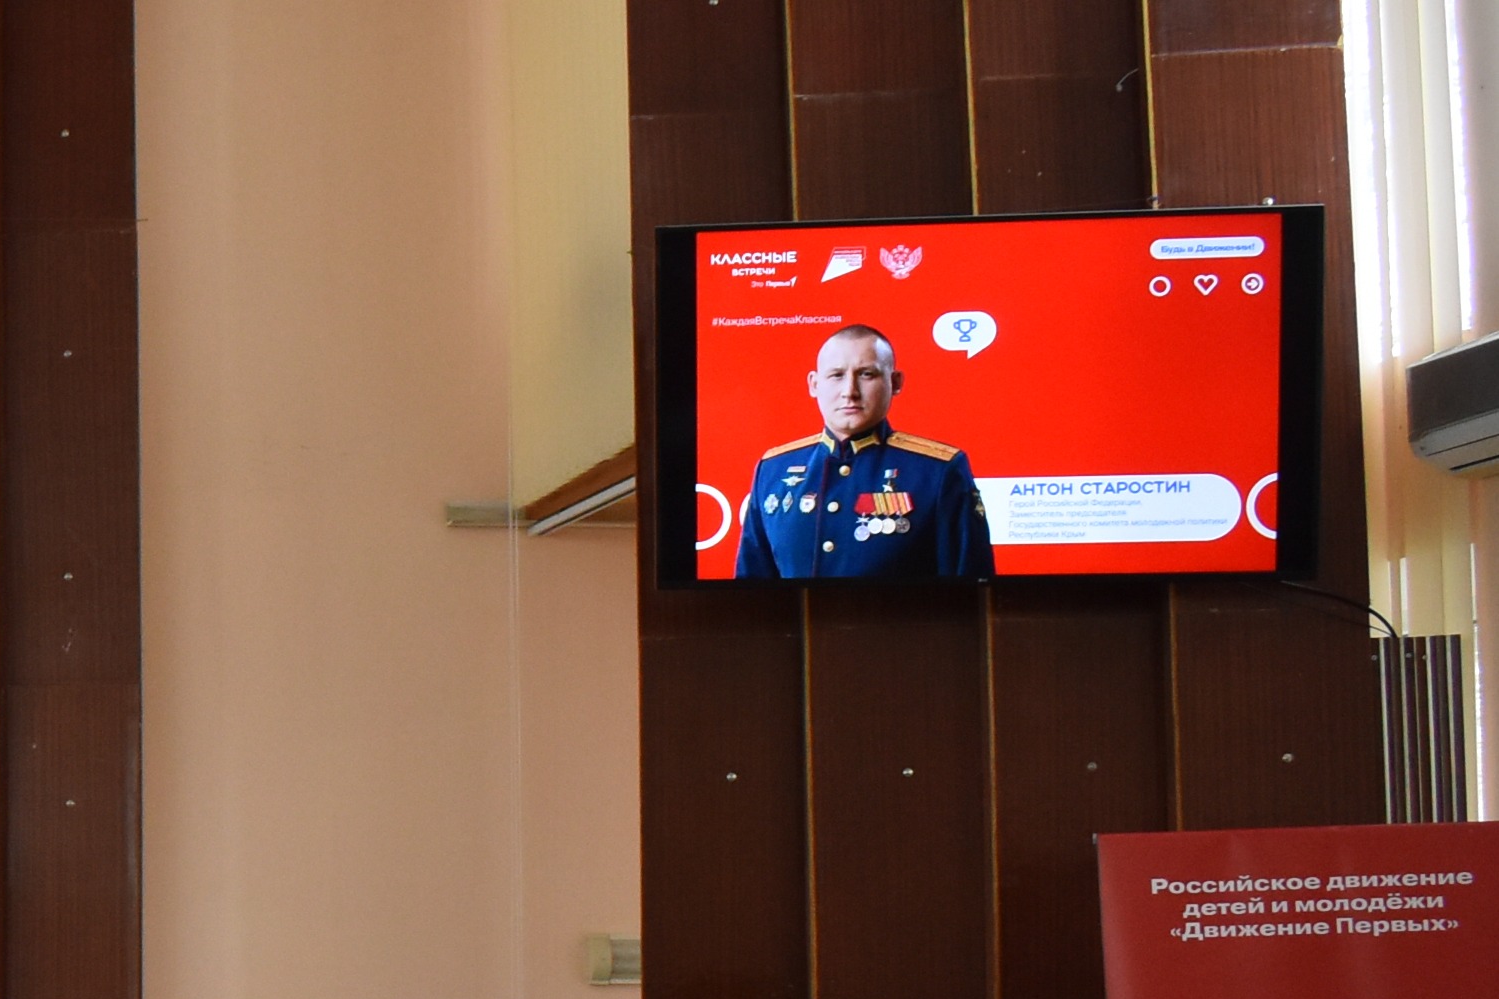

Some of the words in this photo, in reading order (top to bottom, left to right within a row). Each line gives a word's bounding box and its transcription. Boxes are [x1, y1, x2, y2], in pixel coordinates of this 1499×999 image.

[710, 251, 797, 265] КЛАССНЫЕ
[731, 267, 776, 277] ВСТРЕЧИ
[711, 314, 843, 327] #КаждаяВстречаКлассная
[1009, 483, 1073, 496] АНТОН
[1079, 480, 1191, 495] СТАРОСТИН
[1151, 875, 1321, 895] Российское
[1327, 870, 1474, 892] движение
[1183, 897, 1265, 919] детей
[1271, 901, 1288, 914] и
[1295, 893, 1444, 913] молодёжи
[1170, 920, 1330, 941] «Движение
[1336, 917, 1459, 937] Первых»
